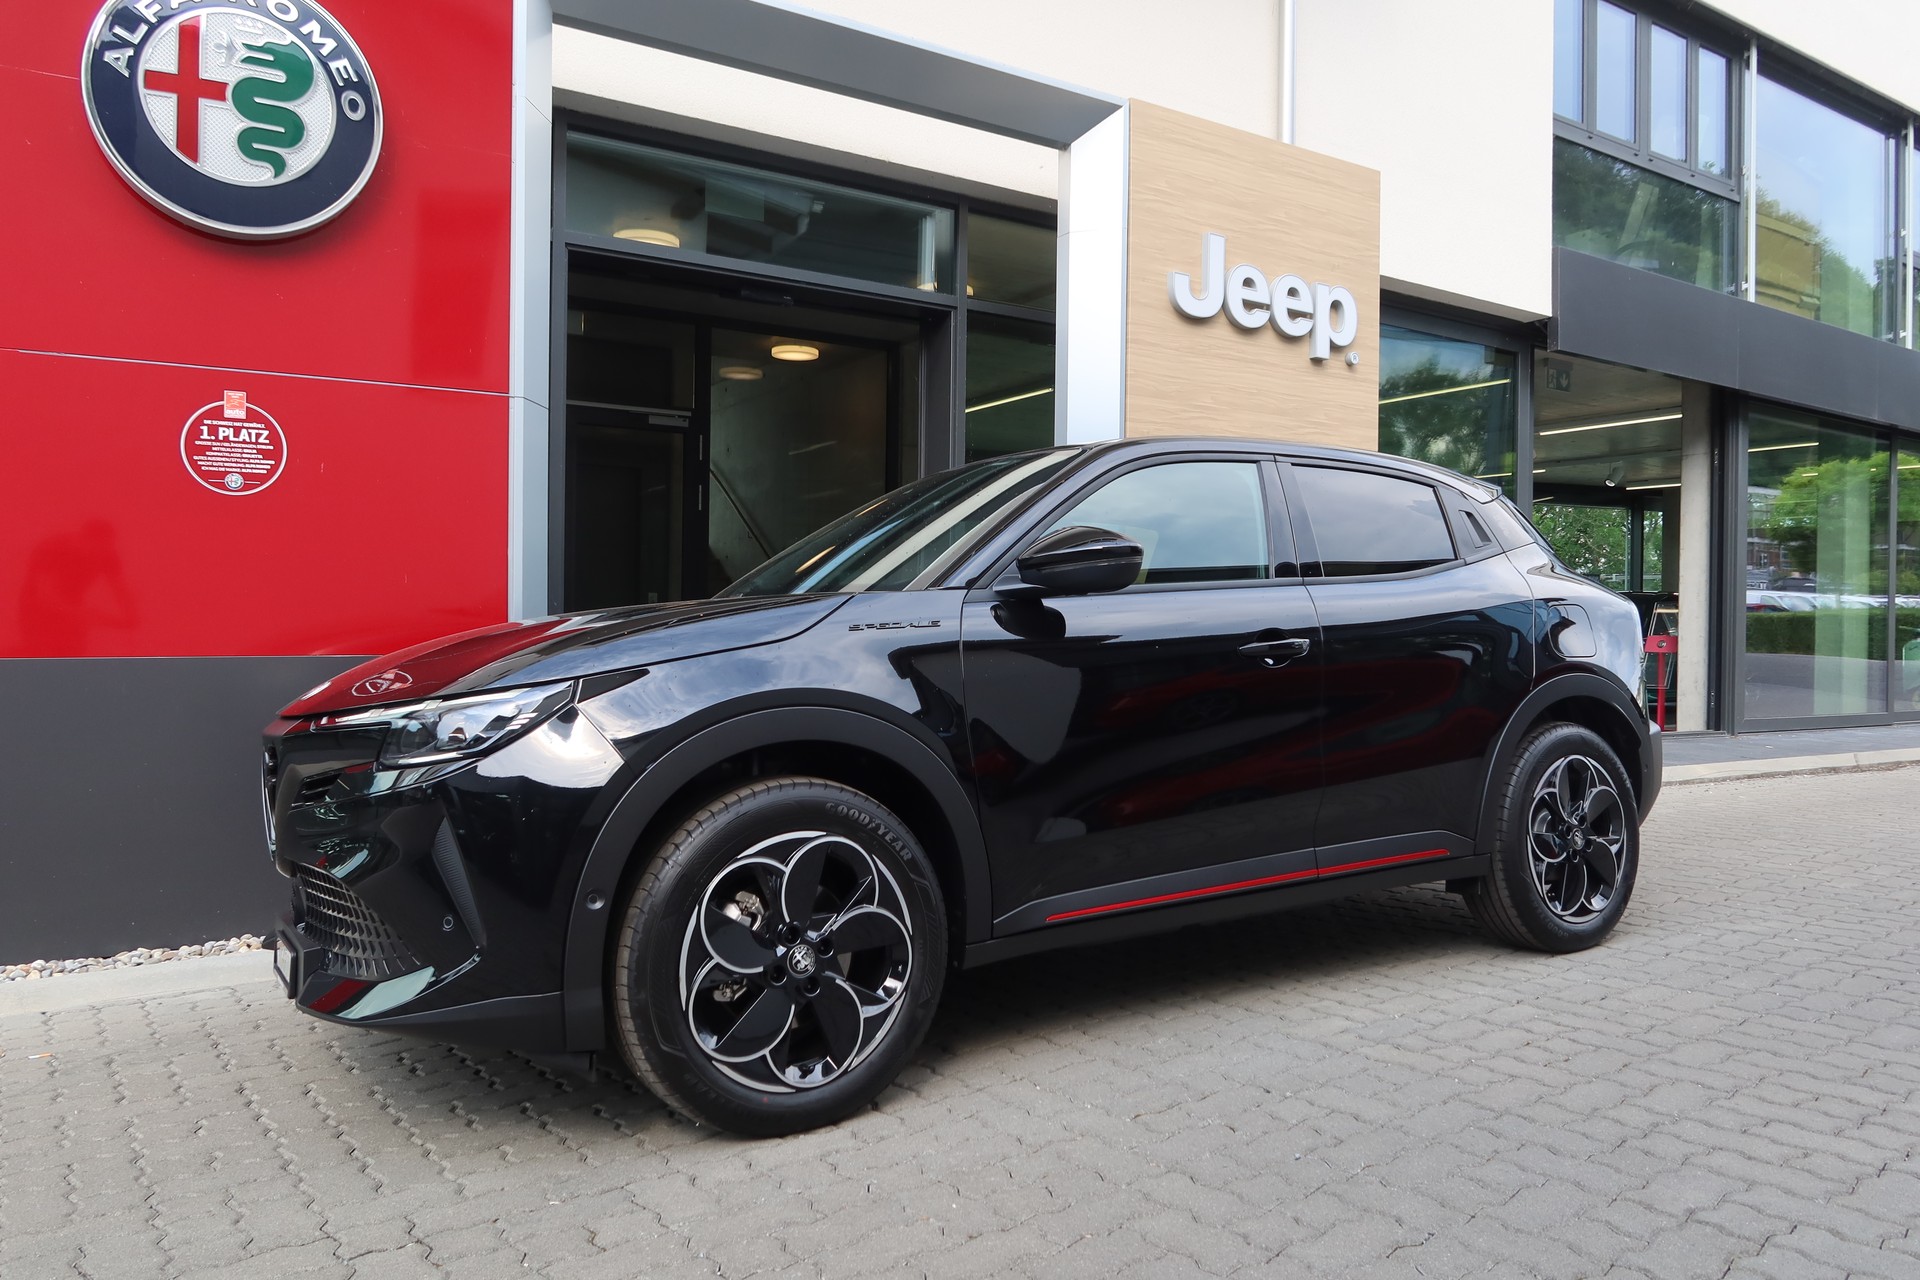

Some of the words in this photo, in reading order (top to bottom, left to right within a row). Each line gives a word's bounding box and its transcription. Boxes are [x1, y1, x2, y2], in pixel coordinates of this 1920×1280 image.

[103, 0, 198, 78] ALF
[230, 0, 366, 121] OMEO
[1167, 231, 1358, 361] Jeep
[199, 425, 216, 440] 1.
[218, 426, 270, 444] PLATZ
